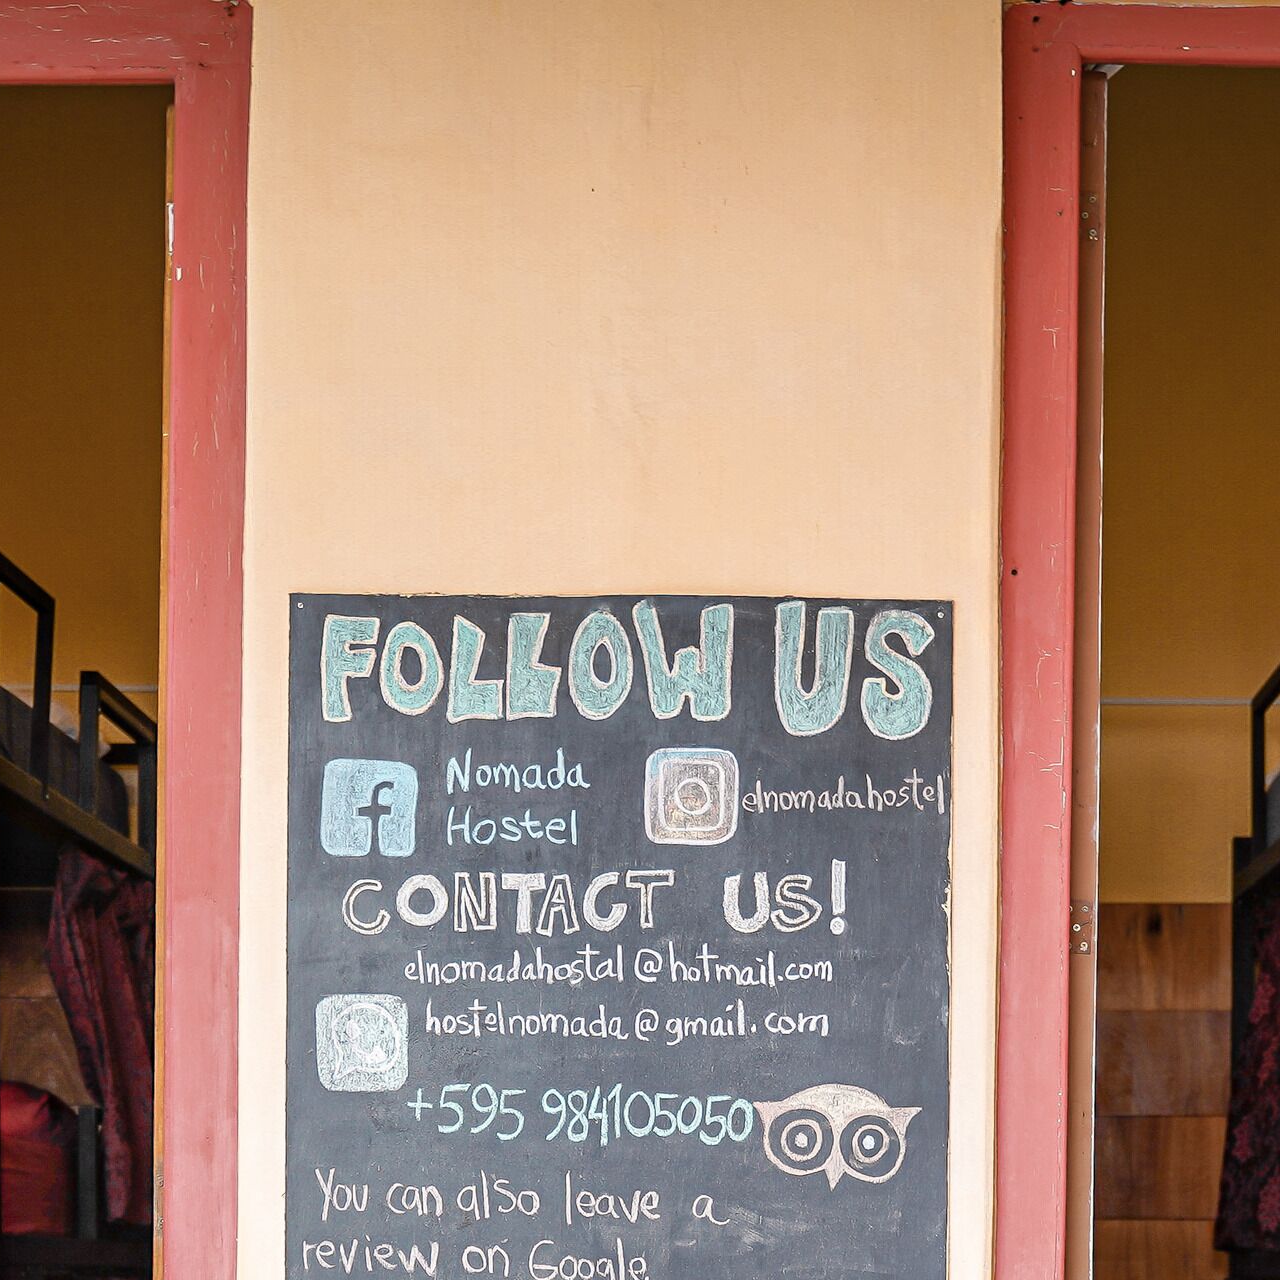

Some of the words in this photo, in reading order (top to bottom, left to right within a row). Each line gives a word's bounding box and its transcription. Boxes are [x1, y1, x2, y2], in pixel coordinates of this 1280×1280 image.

[321, 600, 734, 723] FOLLOW
[774, 600, 936, 741] US
[447, 748, 590, 794] Nomada
[742, 769, 944, 814] elnomadahostel
[447, 805, 577, 845] Hostel
[342, 869, 675, 937] CONTACT
[723, 859, 848, 935] US!
[405, 1083, 526, 1140] +595
[542, 1083, 753, 1147] 984105050
[315, 1168, 368, 1222] You
[386, 1183, 443, 1217] can
[457, 1172, 540, 1220] also
[566, 1170, 660, 1225] leave
[692, 1194, 730, 1226] a
[303, 1237, 439, 1280] review
[462, 1240, 509, 1278] on
